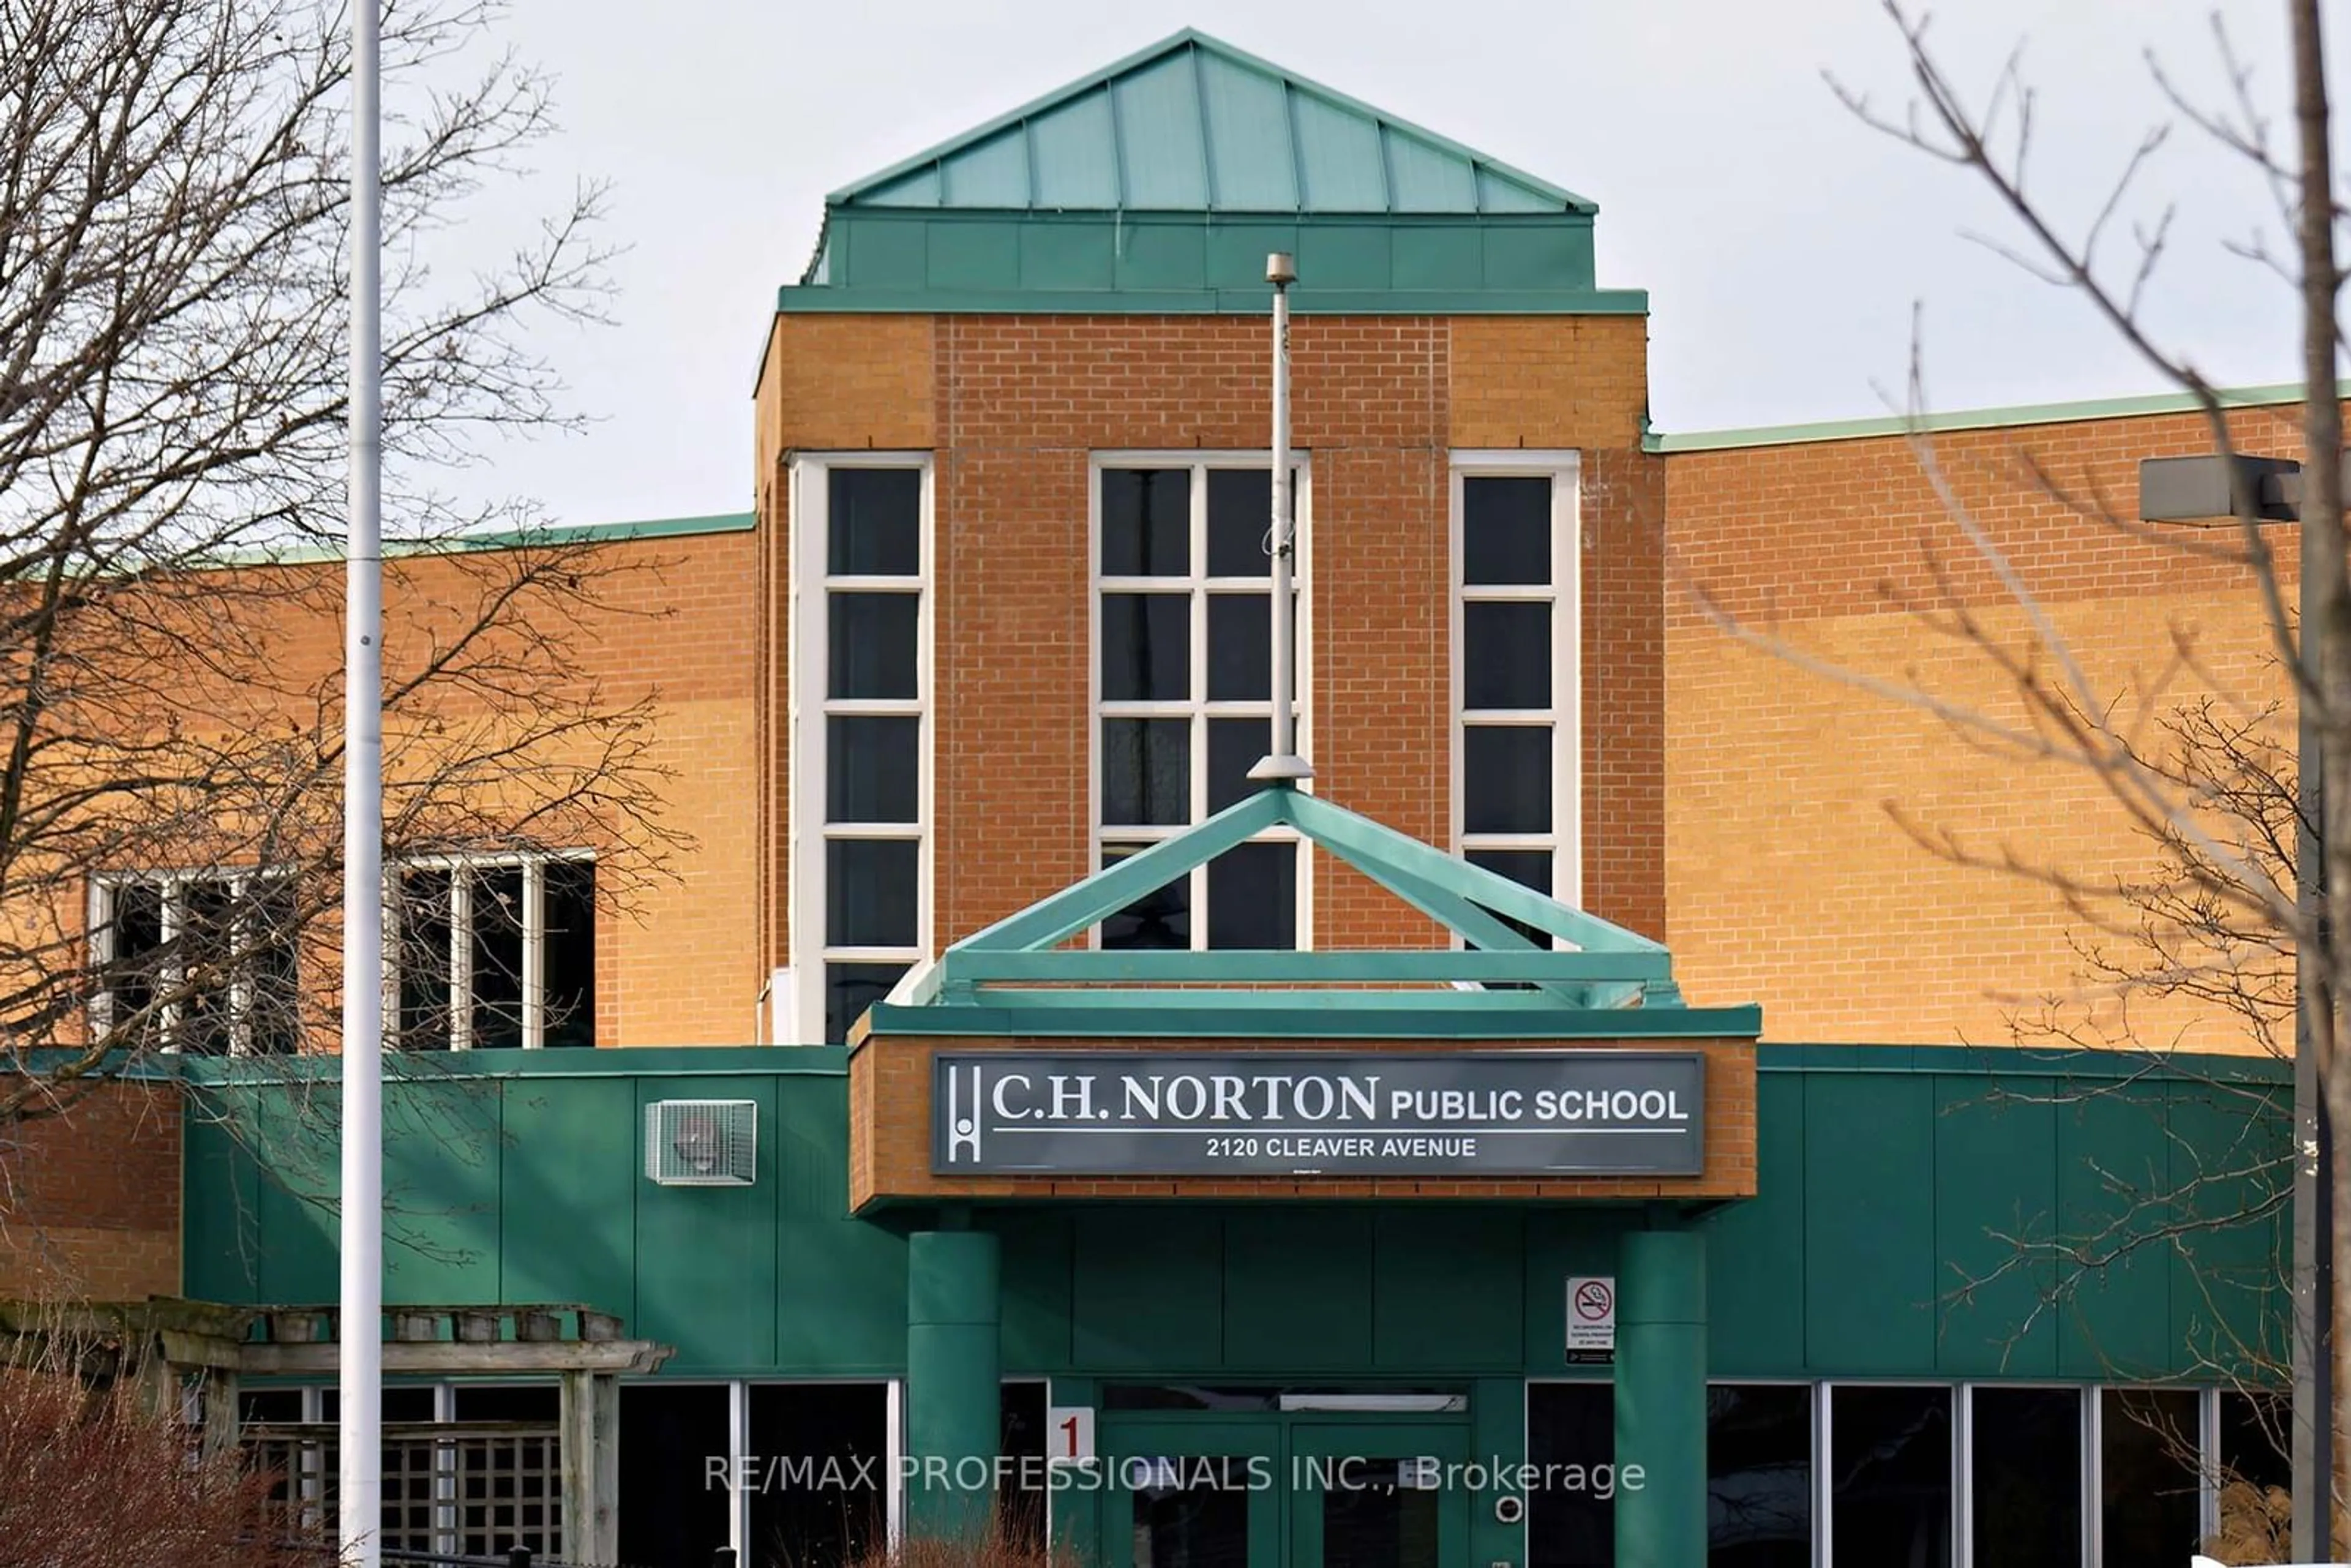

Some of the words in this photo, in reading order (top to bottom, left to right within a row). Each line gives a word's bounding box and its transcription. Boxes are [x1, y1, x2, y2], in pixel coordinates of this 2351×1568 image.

[993, 1075, 1109, 1119] C.H.
[1120, 1076, 1381, 1120] NORTON
[1392, 1090, 1523, 1120] PUBLIC
[1535, 1090, 1689, 1120] SCHOOL
[1207, 1138, 1258, 1157] 2120
[1266, 1138, 1375, 1157] CLEAVER
[1381, 1138, 1476, 1157] AVENUE
[1060, 1416, 1077, 1457] 1
